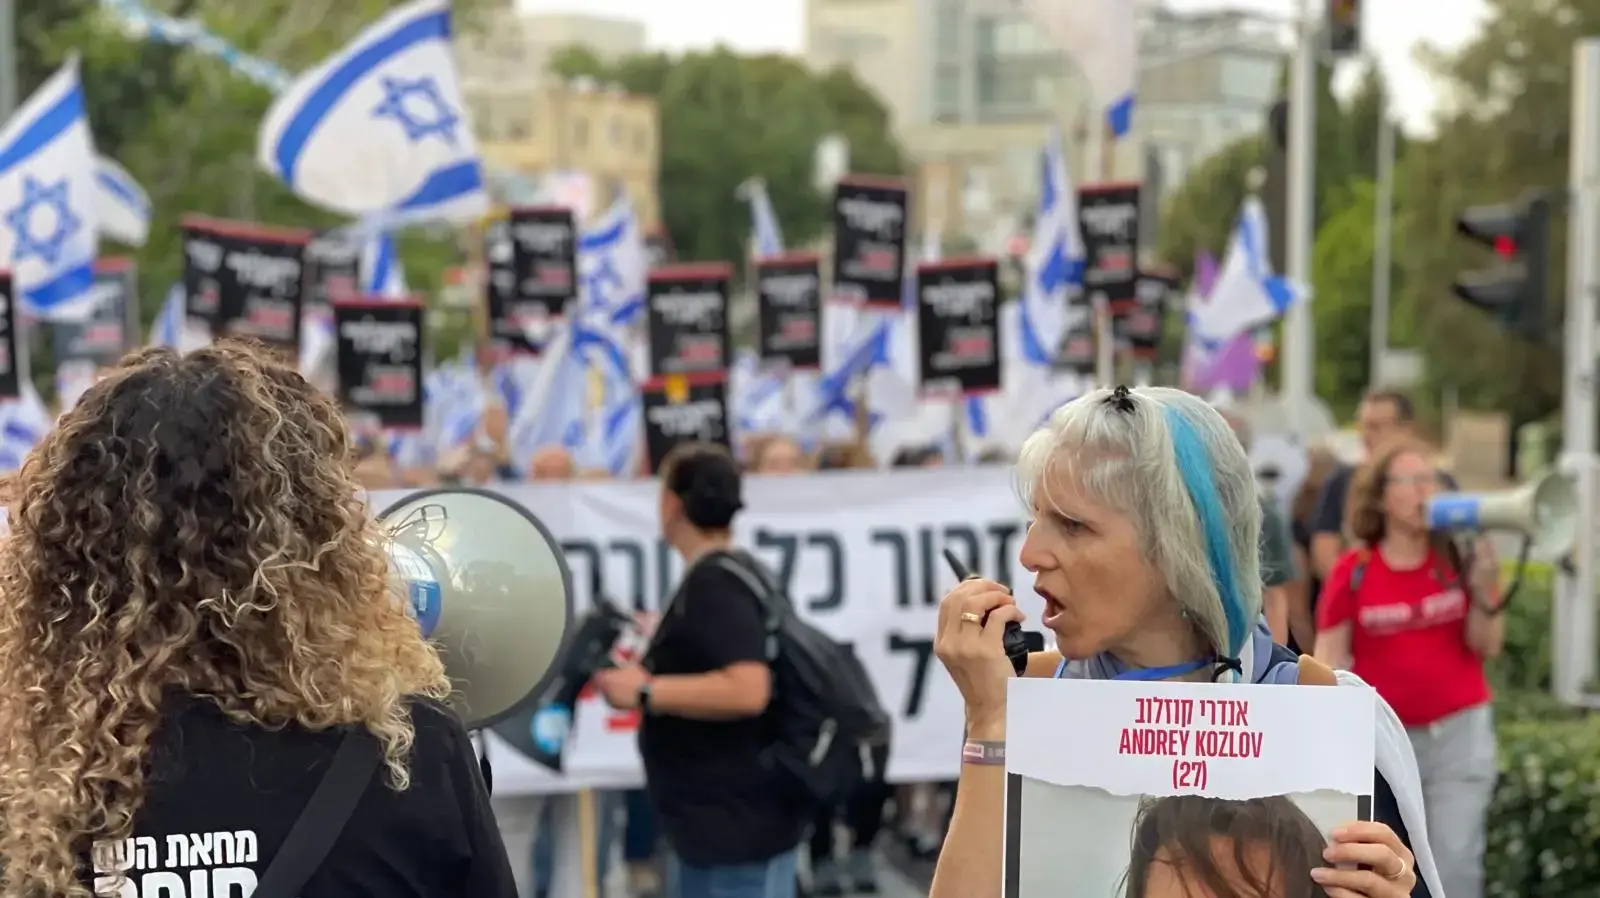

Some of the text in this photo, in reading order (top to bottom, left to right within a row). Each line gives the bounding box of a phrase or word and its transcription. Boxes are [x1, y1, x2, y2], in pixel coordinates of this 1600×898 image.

[1134, 696, 1249, 728] אנדרי קוזלוב
[1118, 728, 1263, 758] ANDREY KOZLOV
[1172, 759, 1207, 790] (27)
[164, 830, 258, 868] מחאת
